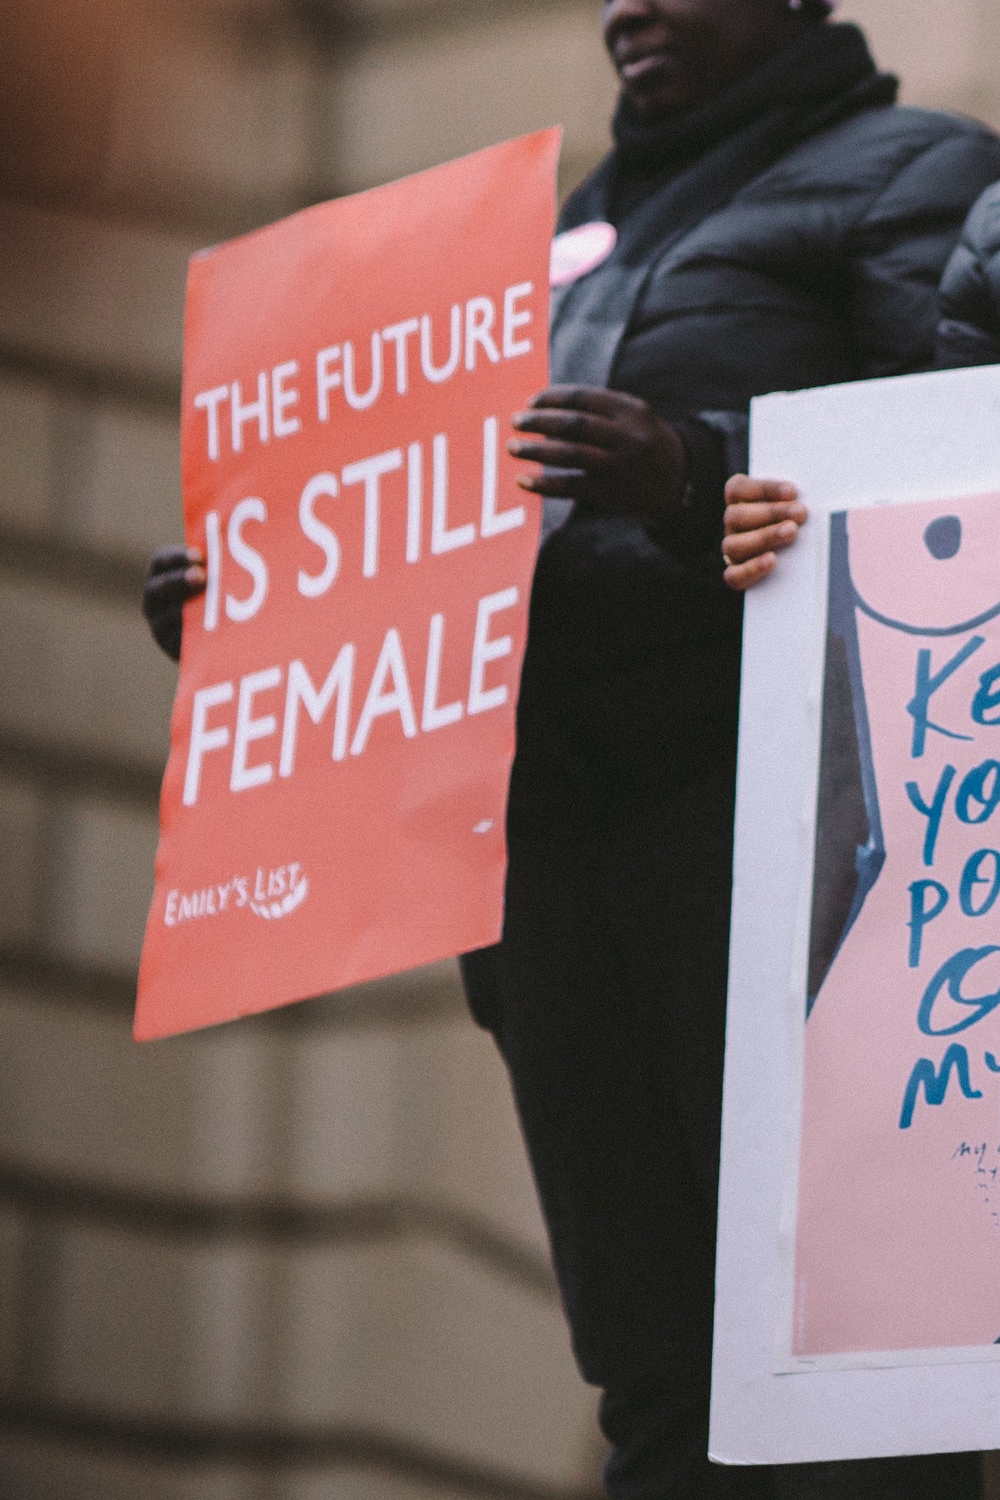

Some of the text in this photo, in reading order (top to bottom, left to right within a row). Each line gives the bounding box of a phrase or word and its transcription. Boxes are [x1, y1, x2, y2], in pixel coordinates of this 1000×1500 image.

[194, 282, 534, 462] THE FUTURE
[203, 416, 527, 631] IS STILL
[182, 587, 519, 807] FEMALE
[164, 861, 302, 927] EMILY'S LIST
